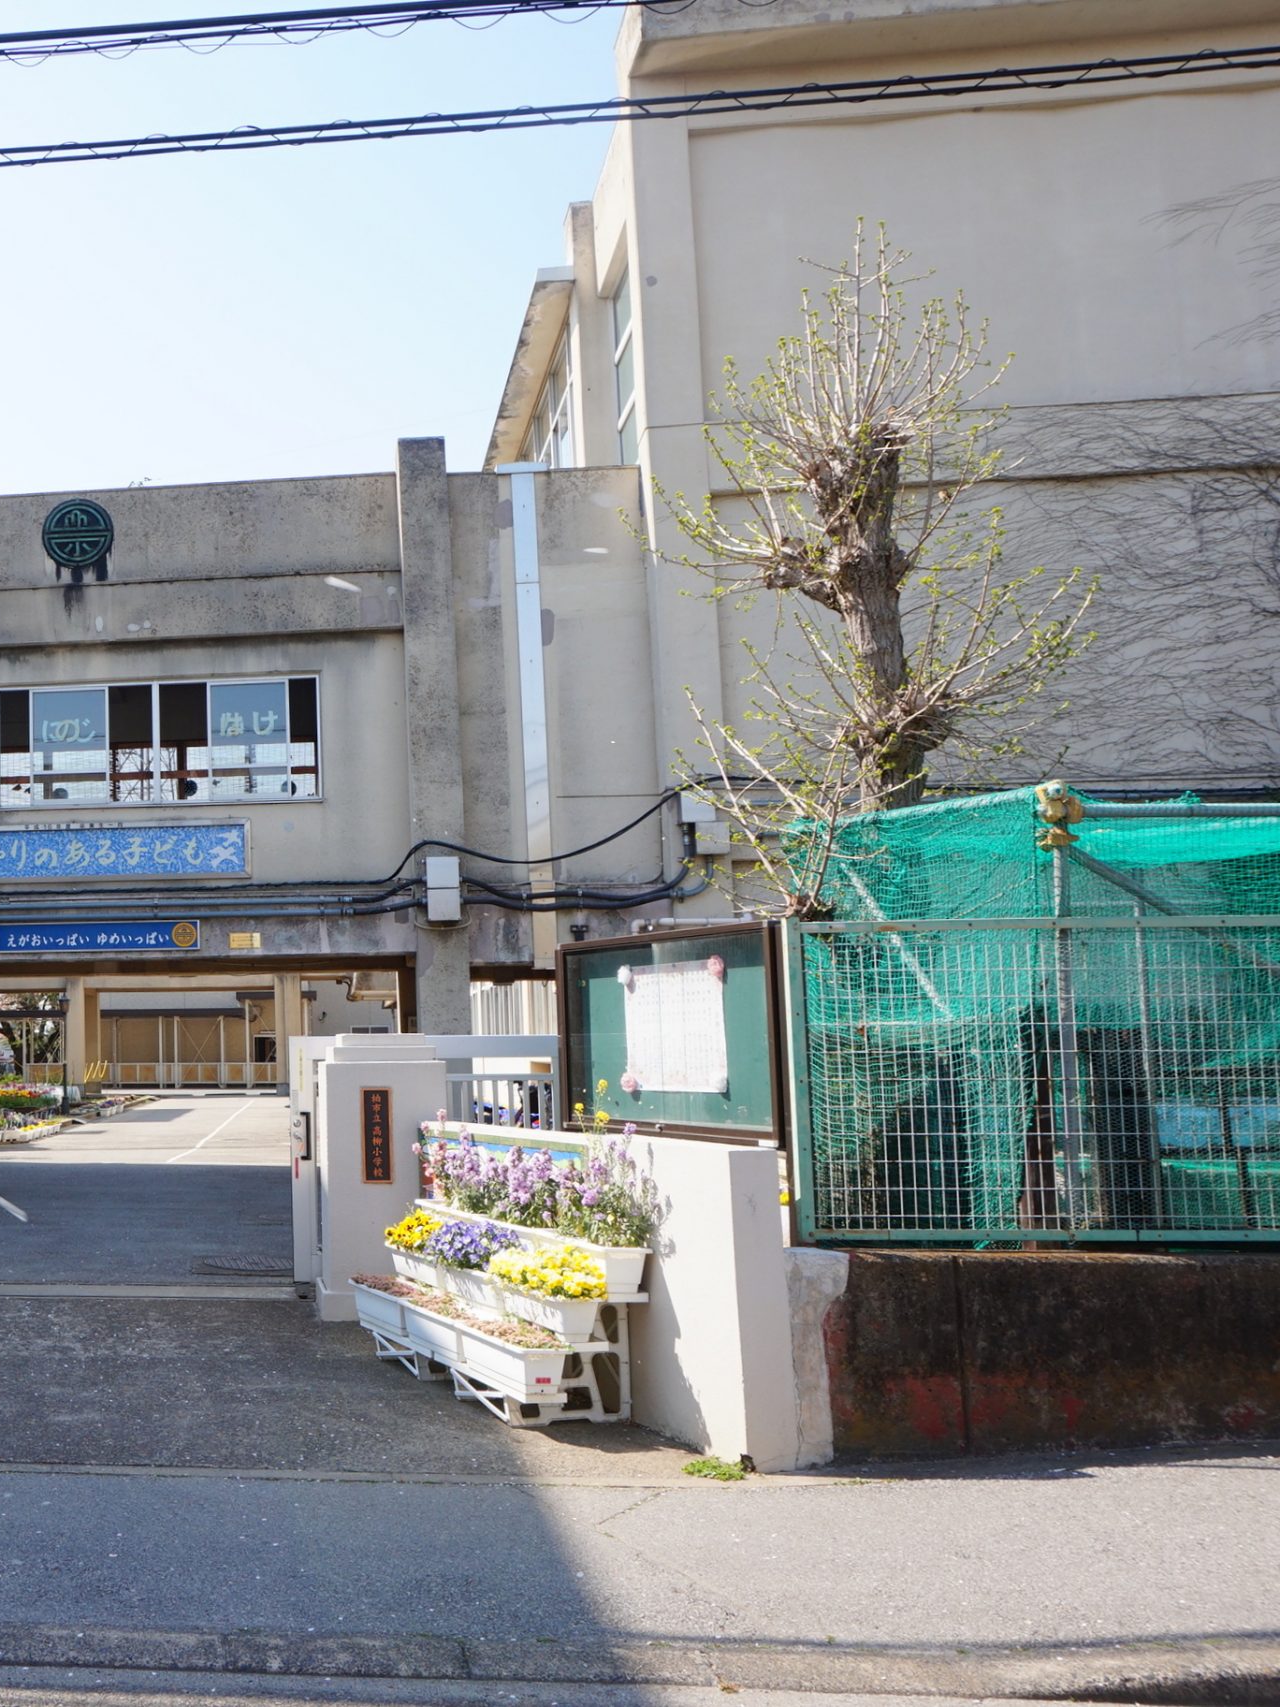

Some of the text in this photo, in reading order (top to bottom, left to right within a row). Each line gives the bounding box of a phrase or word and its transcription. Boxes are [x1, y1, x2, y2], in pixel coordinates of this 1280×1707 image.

[7, 933, 89, 947] えがおいっぱい
[97, 931, 169, 945] ゆめいっぱい
